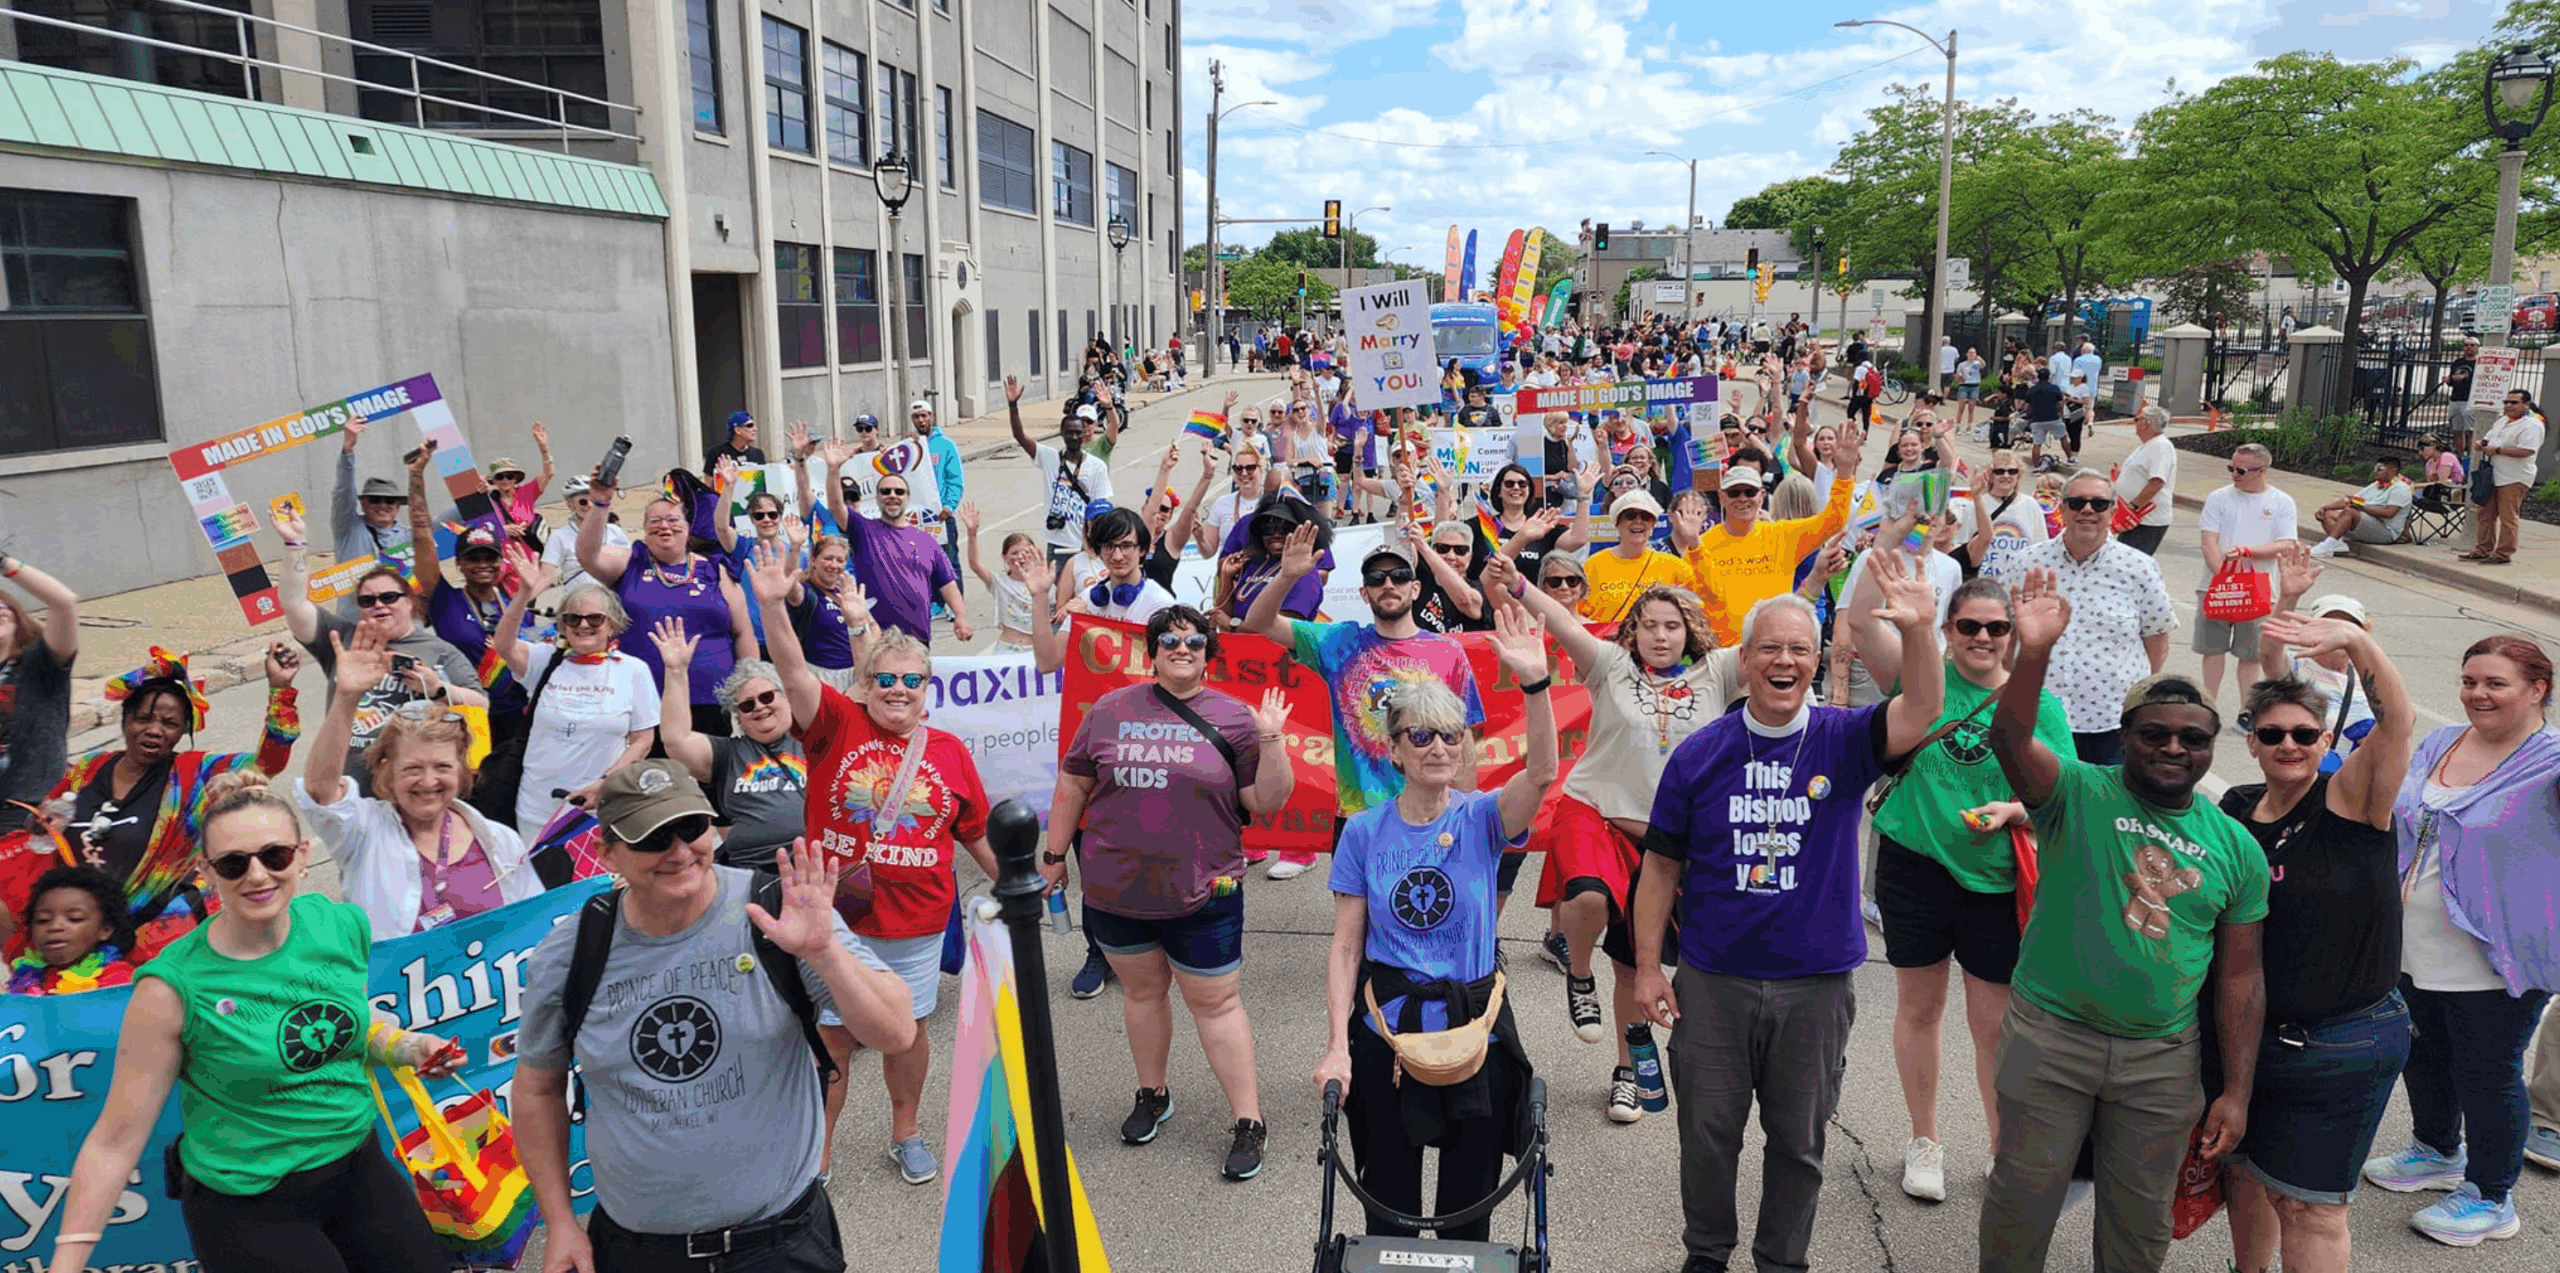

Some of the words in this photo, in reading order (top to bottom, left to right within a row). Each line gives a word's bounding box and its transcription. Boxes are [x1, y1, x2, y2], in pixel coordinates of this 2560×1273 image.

[1361, 296, 1365, 311] I
[1371, 289, 1409, 309] Will
[2480, 288, 2489, 302] 2
[1361, 333, 1420, 350] Marry
[1374, 373, 1423, 391] YOU!
[1537, 391, 1577, 408] MADE
[1579, 389, 1595, 404] IN
[1599, 386, 1643, 404] GOD'S
[1646, 381, 1694, 400] IMAGE
[201, 433, 262, 466] MADE
[261, 418, 286, 447] IN
[286, 404, 347, 440] GOD'S
[346, 386, 412, 420] IMAGE
[1520, 551, 1539, 560] YOU
[984, 721, 1060, 755] people
[1119, 720, 1219, 743] PROTEC
[1116, 743, 1195, 764] TRANS
[734, 776, 778, 794] Proud
[1113, 767, 1169, 789] KIDS
[1743, 761, 1793, 789] This
[1728, 794, 1812, 826] Bishop
[822, 828, 857, 858] BE
[864, 842, 939, 869] KIND
[1733, 829, 1802, 857] loves
[2144, 823, 2207, 862] SNAP!
[1377, 849, 1412, 880] PRINCE
[607, 972, 657, 1019] PRINCE
[663, 966, 681, 995] OF
[690, 956, 738, 996] PEACE
[693, 1053, 746, 1108] CHURCH
